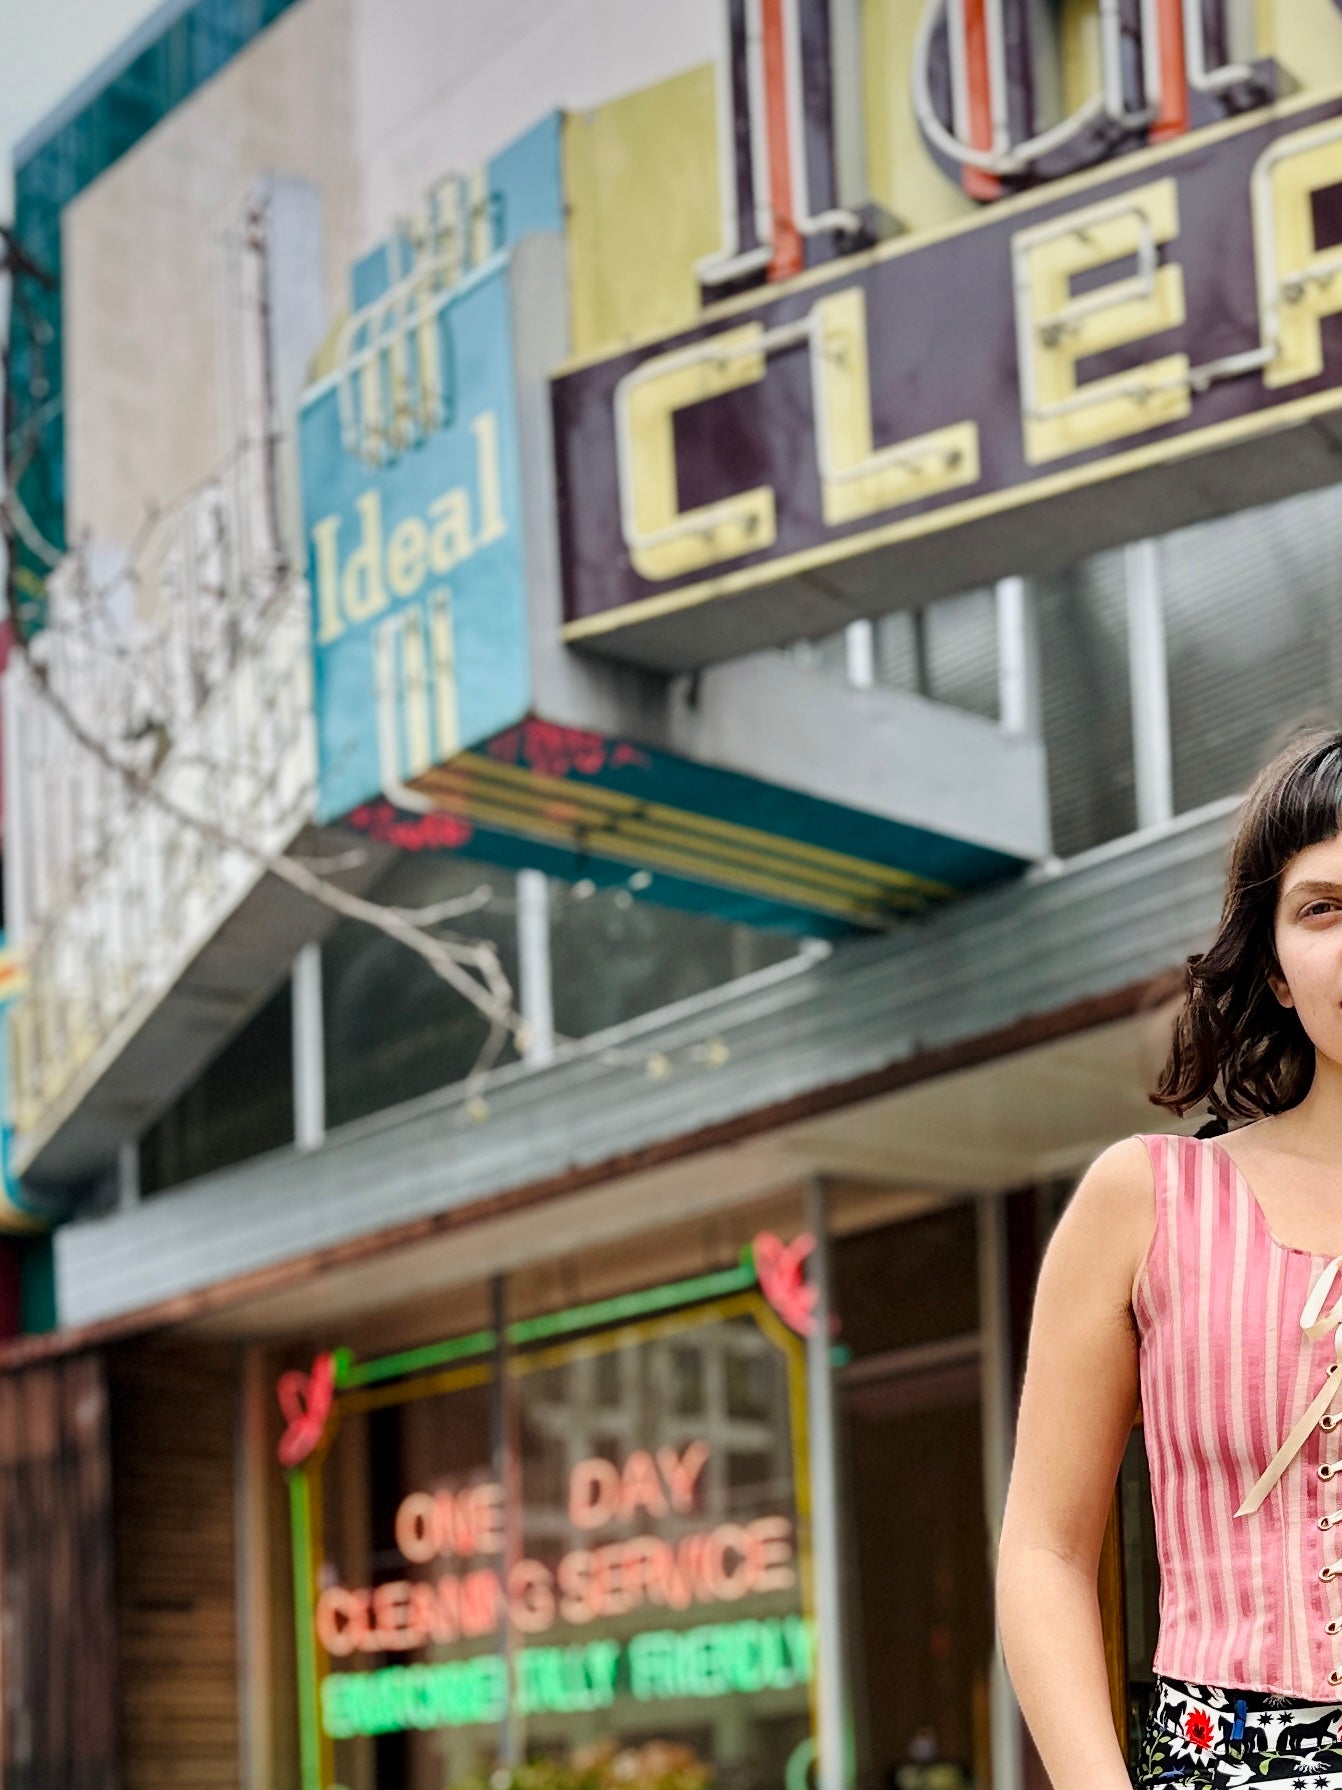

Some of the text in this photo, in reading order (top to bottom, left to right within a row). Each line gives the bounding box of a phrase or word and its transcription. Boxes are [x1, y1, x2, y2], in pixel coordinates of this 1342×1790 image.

[312, 411, 508, 647] Ideal
[394, 1439, 711, 1564] ONE DAY
[556, 1515, 797, 1624] SERVICE
